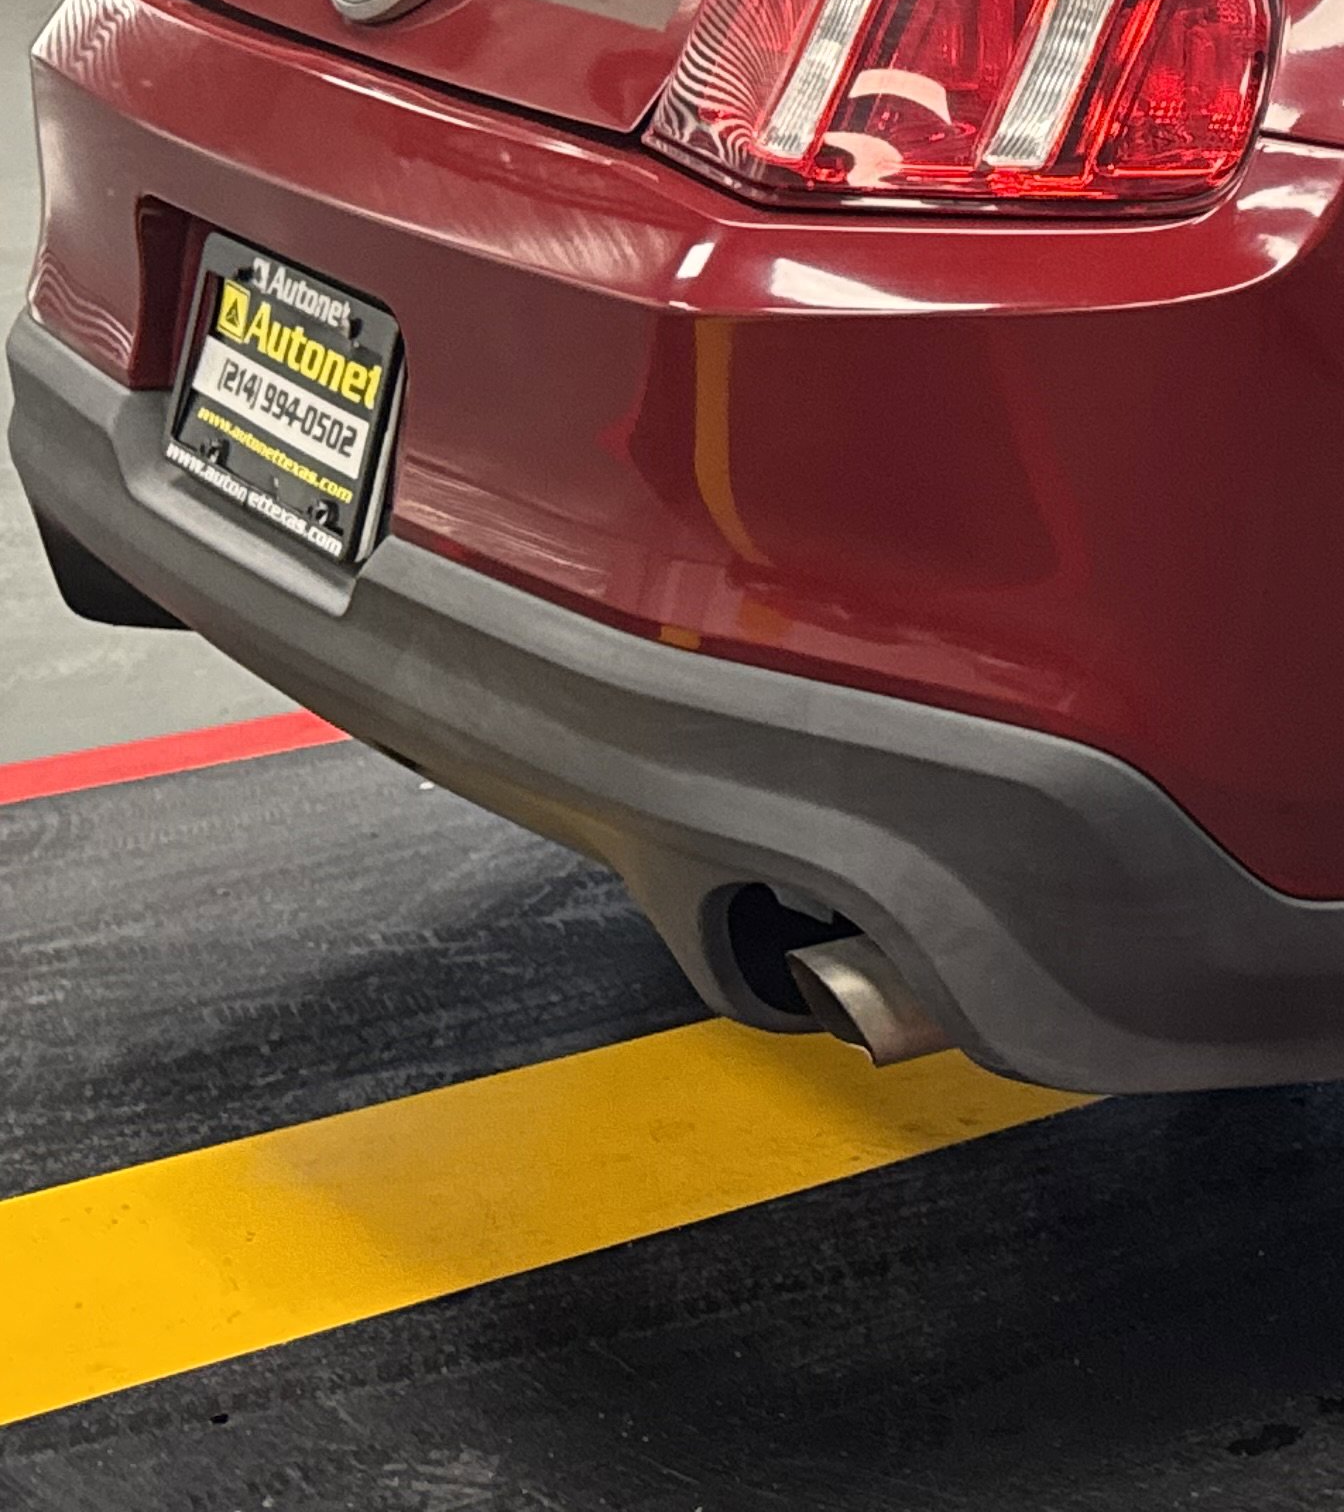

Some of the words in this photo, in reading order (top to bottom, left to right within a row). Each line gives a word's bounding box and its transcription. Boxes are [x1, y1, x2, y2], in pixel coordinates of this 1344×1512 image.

[268, 267, 351, 328] Autonet
[246, 301, 382, 408] Autonet
[197, 407, 353, 504] www.autonettexas.com
[218, 358, 263, 410] (214)
[263, 383, 357, 458] 994-0502
